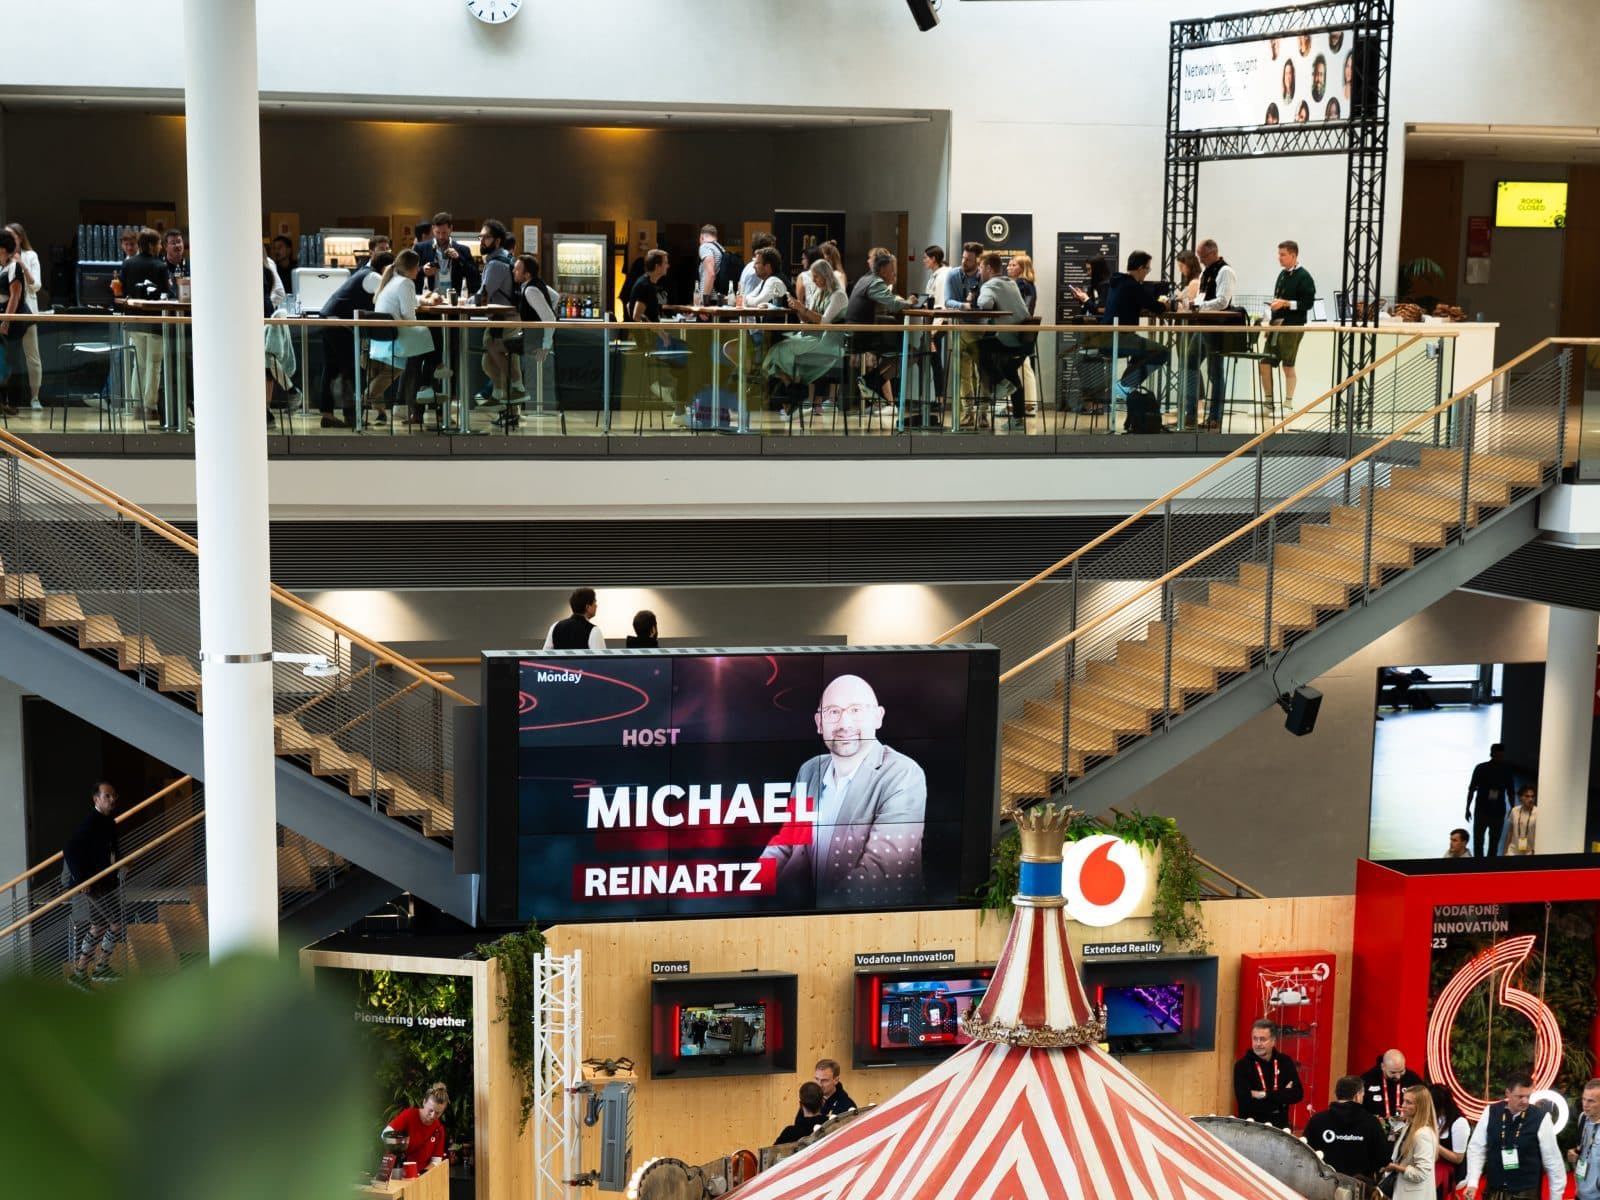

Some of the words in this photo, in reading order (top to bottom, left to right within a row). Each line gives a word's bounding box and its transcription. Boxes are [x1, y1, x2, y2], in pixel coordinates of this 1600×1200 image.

[1184, 87, 1192, 101] to
[1193, 89, 1206, 103] you
[1207, 84, 1216, 102] by
[537, 671, 582, 684] Monday
[622, 728, 680, 747] HOST
[587, 782, 822, 829] MICHAEL
[584, 862, 762, 897] REINARTZ
[1434, 904, 1499, 917] VODAFONE
[1434, 920, 1509, 934] INNOVATION
[1083, 944, 1127, 955] Extended
[1129, 943, 1162, 953] Reality
[856, 955, 902, 965] Vodafone
[903, 952, 954, 962] Innovation
[653, 963, 688, 973] Drones
[354, 1012, 413, 1028] Pioneering
[417, 1015, 467, 1028] together
[1336, 1134, 1364, 1142] vodafone
